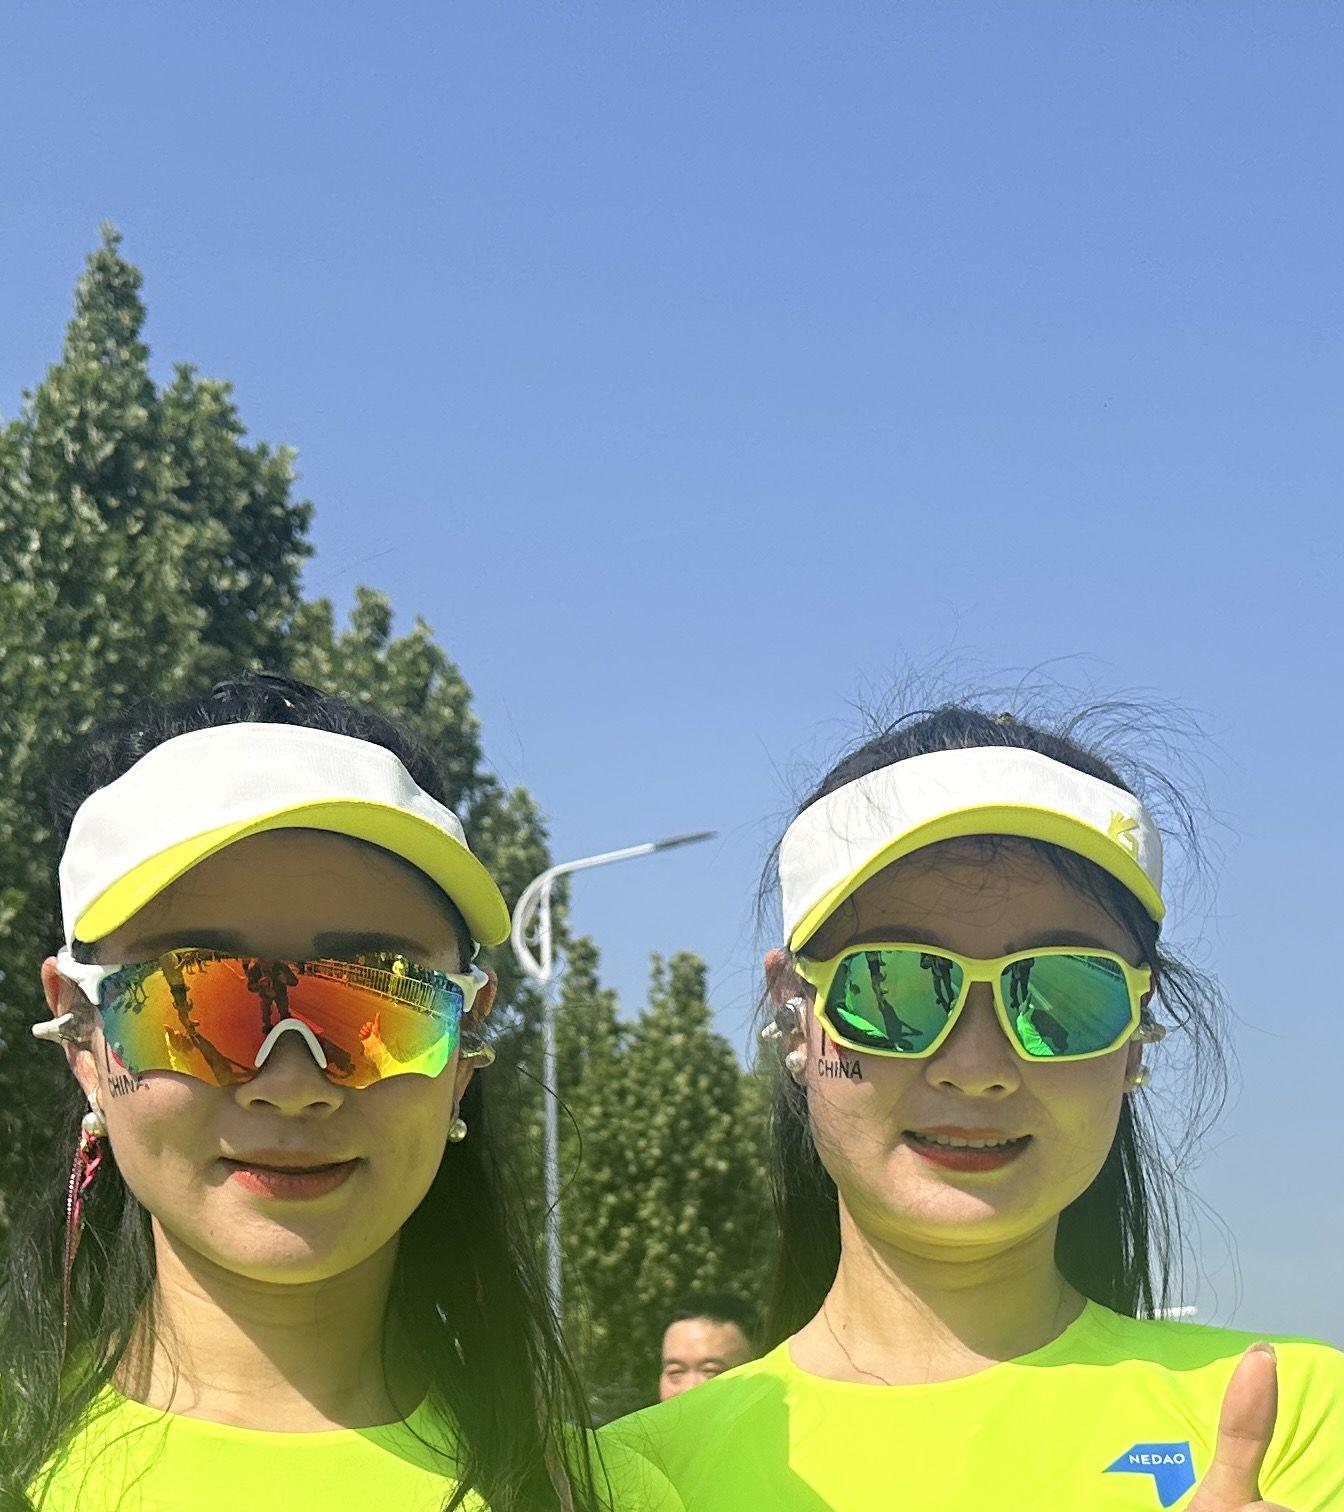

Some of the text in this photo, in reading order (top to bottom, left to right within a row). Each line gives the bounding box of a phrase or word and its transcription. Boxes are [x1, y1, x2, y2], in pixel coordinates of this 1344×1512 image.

[818, 1058, 863, 1080] CHINA
[108, 1075, 150, 1098] CHINA
[1128, 1453, 1186, 1465] NEDAO
